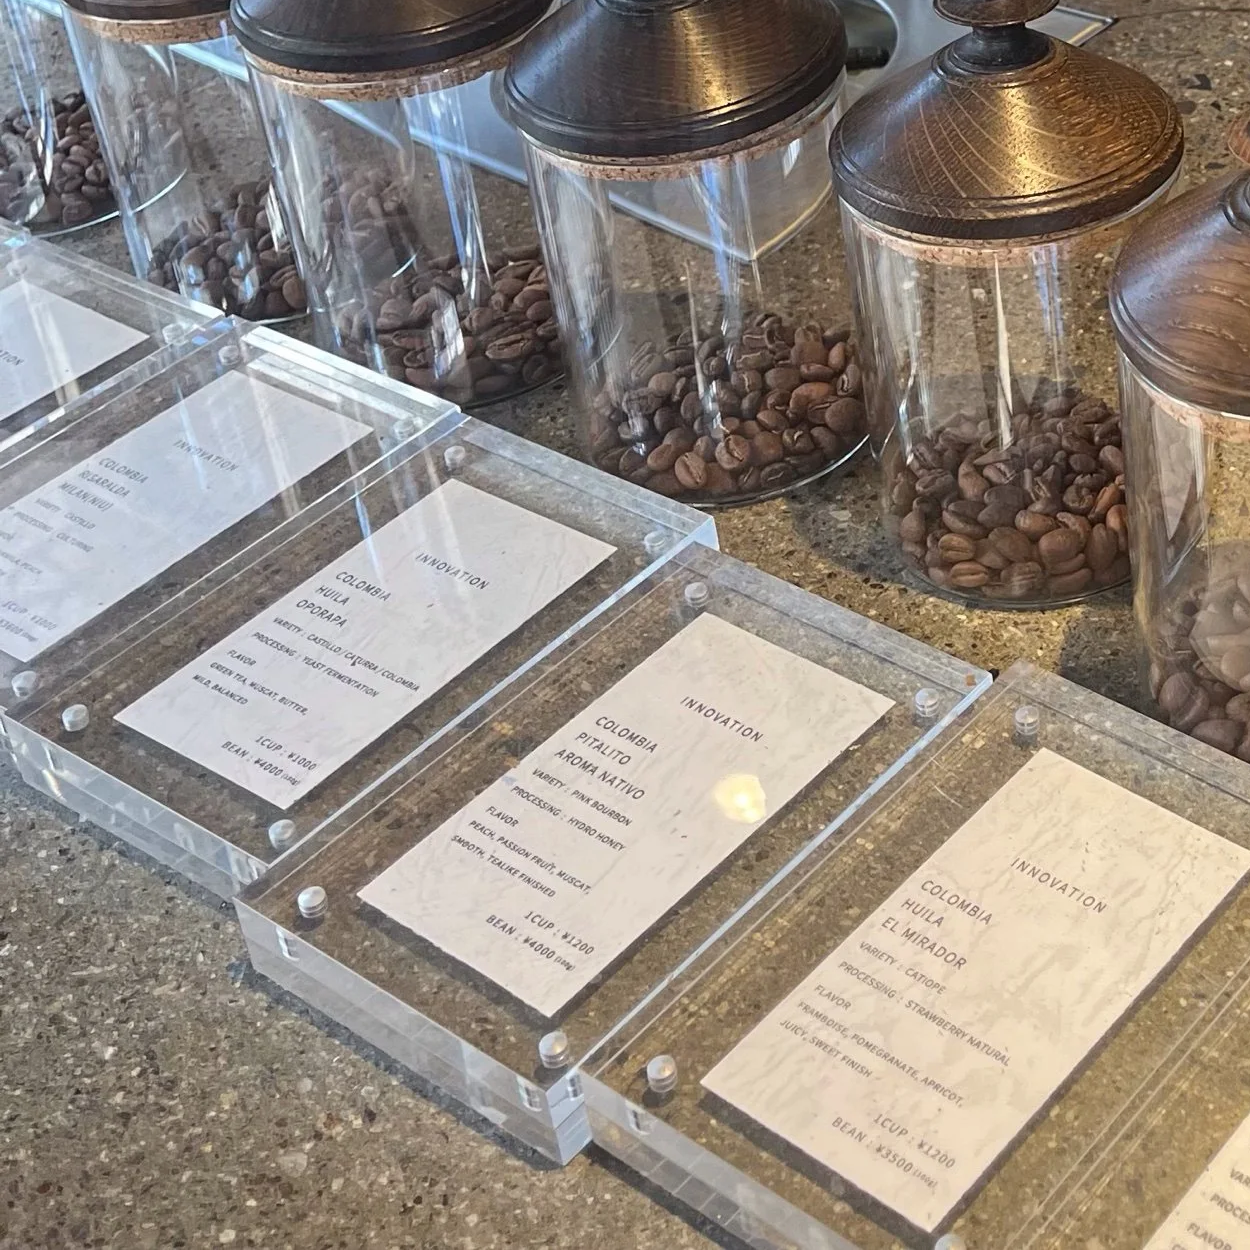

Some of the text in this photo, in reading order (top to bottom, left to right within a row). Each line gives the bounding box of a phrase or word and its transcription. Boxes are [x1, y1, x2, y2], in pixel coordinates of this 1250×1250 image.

[78, 470, 131, 498] RISARALDA
[99, 458, 149, 484] COLOMBIA
[336, 571, 392, 602] COLOMBIA
[415, 553, 490, 590] INNOVATION
[296, 599, 348, 628] OPORAPA
[315, 585, 350, 606] HUILA
[381, 670, 420, 692] COLOMBIA
[595, 716, 658, 754] COLOMBIA
[680, 696, 764, 742] INNOVATION
[575, 732, 632, 766] PITALITO
[554, 749, 645, 800] AROMA NATIVO
[486, 806, 519, 828] FLAVOR
[510, 786, 562, 817] PROCESSING
[567, 817, 598, 837] HYDRO
[595, 833, 626, 852] HONEY
[532, 768, 567, 789] VARIETY
[571, 790, 593, 805] PINK
[590, 801, 633, 827] BOURBON
[496, 836, 532, 859] PASSION
[487, 854, 520, 877] TEALIKE
[518, 873, 556, 898] FINISHED
[1010, 857, 1107, 914] INNOVATION
[901, 898, 945, 928] HUILA
[921, 880, 993, 925] COLOMBIA
[486, 914, 517, 936] BEAN
[523, 936, 556, 959] ¥4000
[524, 911, 555, 930] 1CUP
[561, 932, 595, 955] ¥1200
[881, 917, 967, 971] EL MIRADOR
[860, 941, 898, 966] VARIETY
[905, 968, 947, 995] CATIOPE
[814, 984, 852, 1011] FLAVOR
[838, 961, 897, 999] PROCESSING
[905, 1000, 969, 1040] STRAWBERRY
[966, 1036, 1010, 1067] NATURAL
[809, 1036, 842, 1058] SWEET
[840, 1055, 873, 1078] FINISH
[832, 1116, 868, 1143] BEAN
[875, 1144, 914, 1173] ¥3500
[873, 1114, 909, 1137] 1CUP
[917, 1139, 956, 1169] ¥1200
